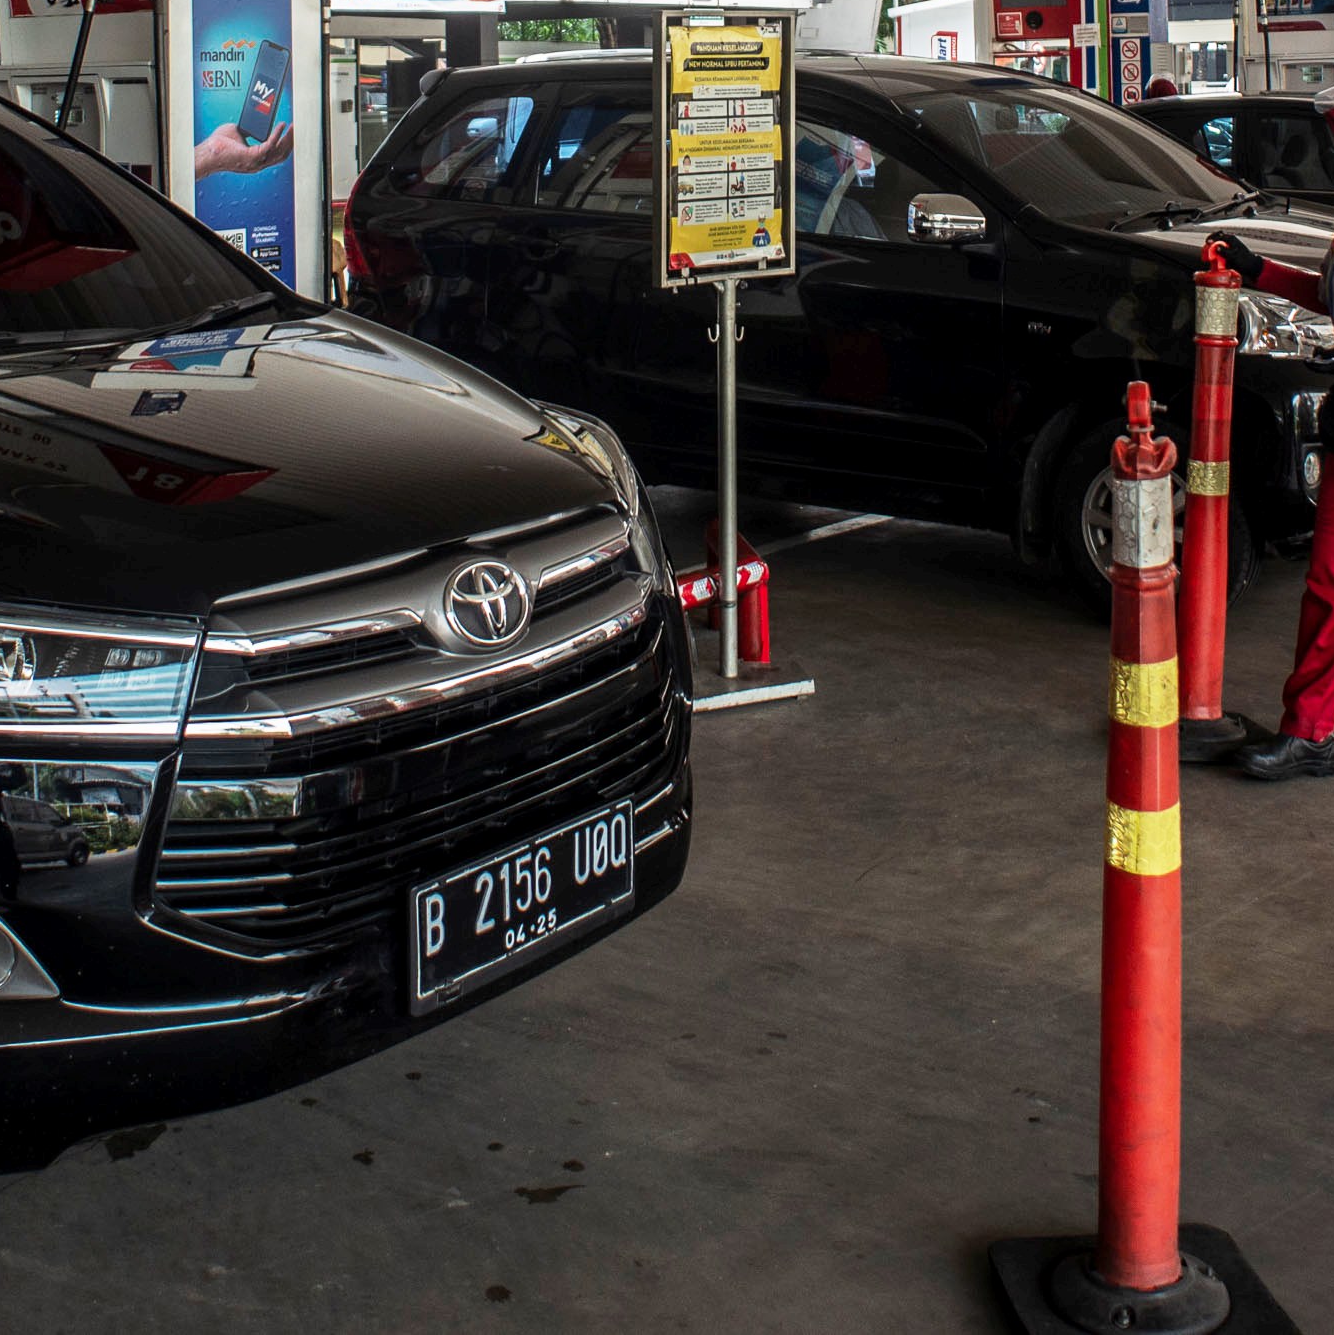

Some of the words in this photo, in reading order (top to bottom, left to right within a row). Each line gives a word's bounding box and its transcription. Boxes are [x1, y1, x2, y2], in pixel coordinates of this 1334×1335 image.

[200, 47, 245, 62] mandiri
[702, 60, 724, 68] NORMAL
[215, 70, 241, 88] BNI
[426, 892, 445, 958] B
[475, 846, 552, 936] 2156
